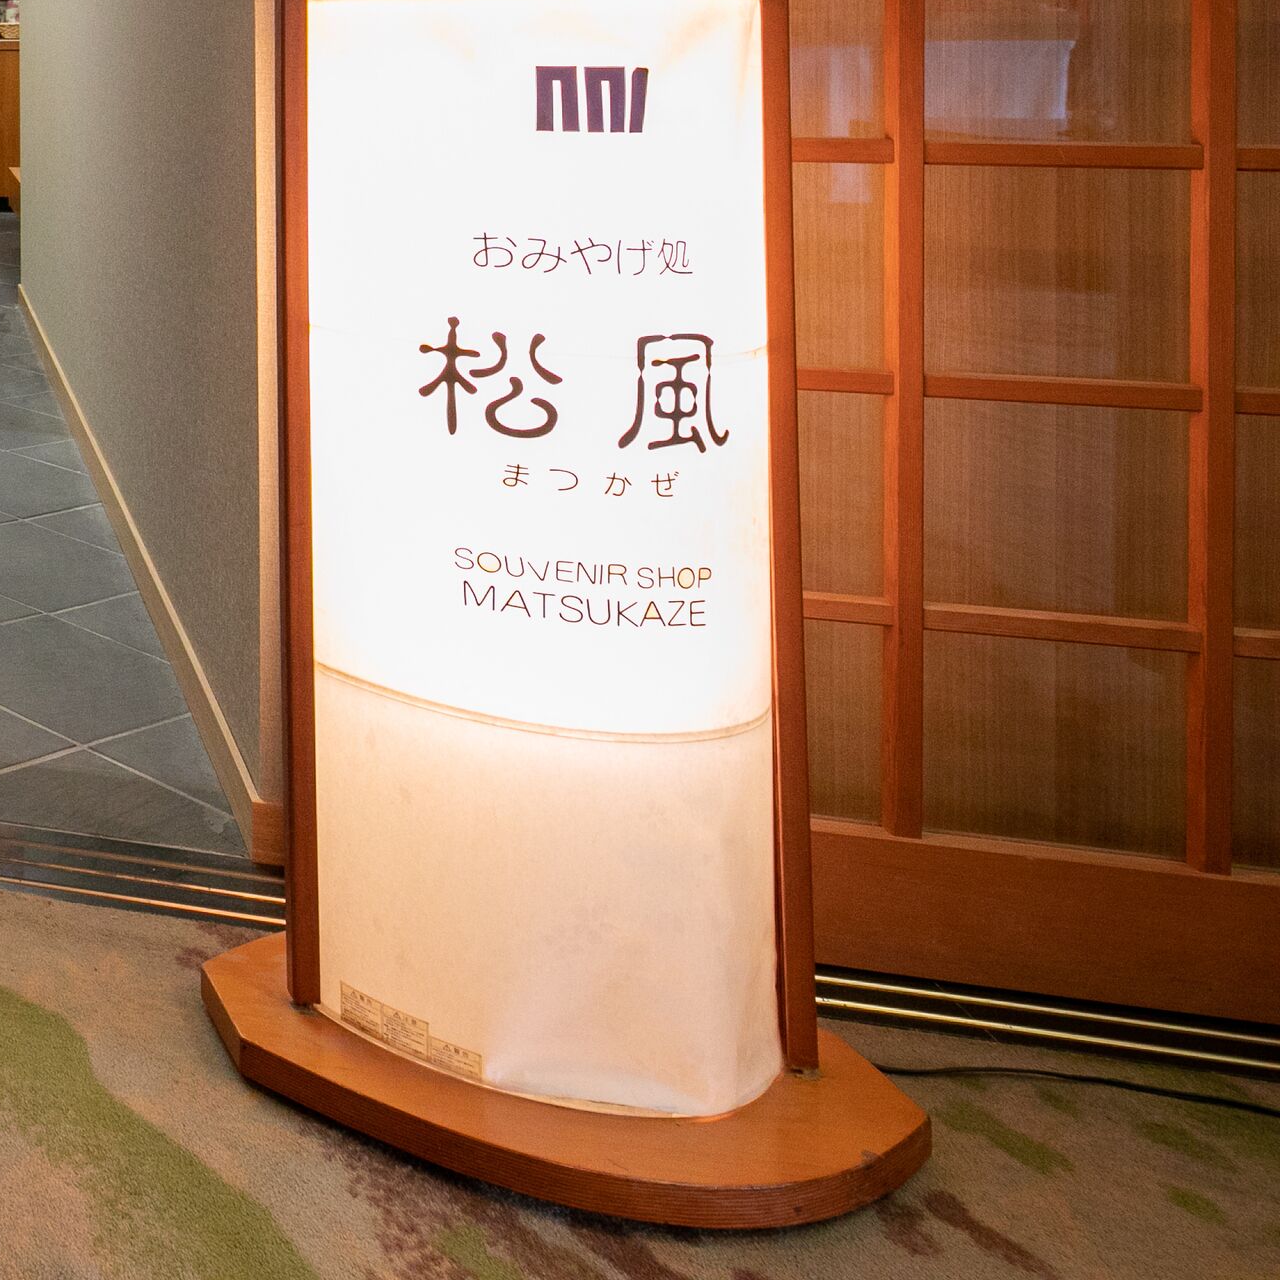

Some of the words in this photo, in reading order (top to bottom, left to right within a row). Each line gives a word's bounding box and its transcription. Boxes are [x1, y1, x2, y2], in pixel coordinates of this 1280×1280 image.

[473, 232, 693, 276] おみやげ処
[418, 316, 730, 453] 松風
[502, 464, 680, 497] まつかぜ
[454, 547, 628, 586] SOUVENIR
[636, 566, 712, 590] SHOP
[463, 580, 707, 628] MATSUKAZE
